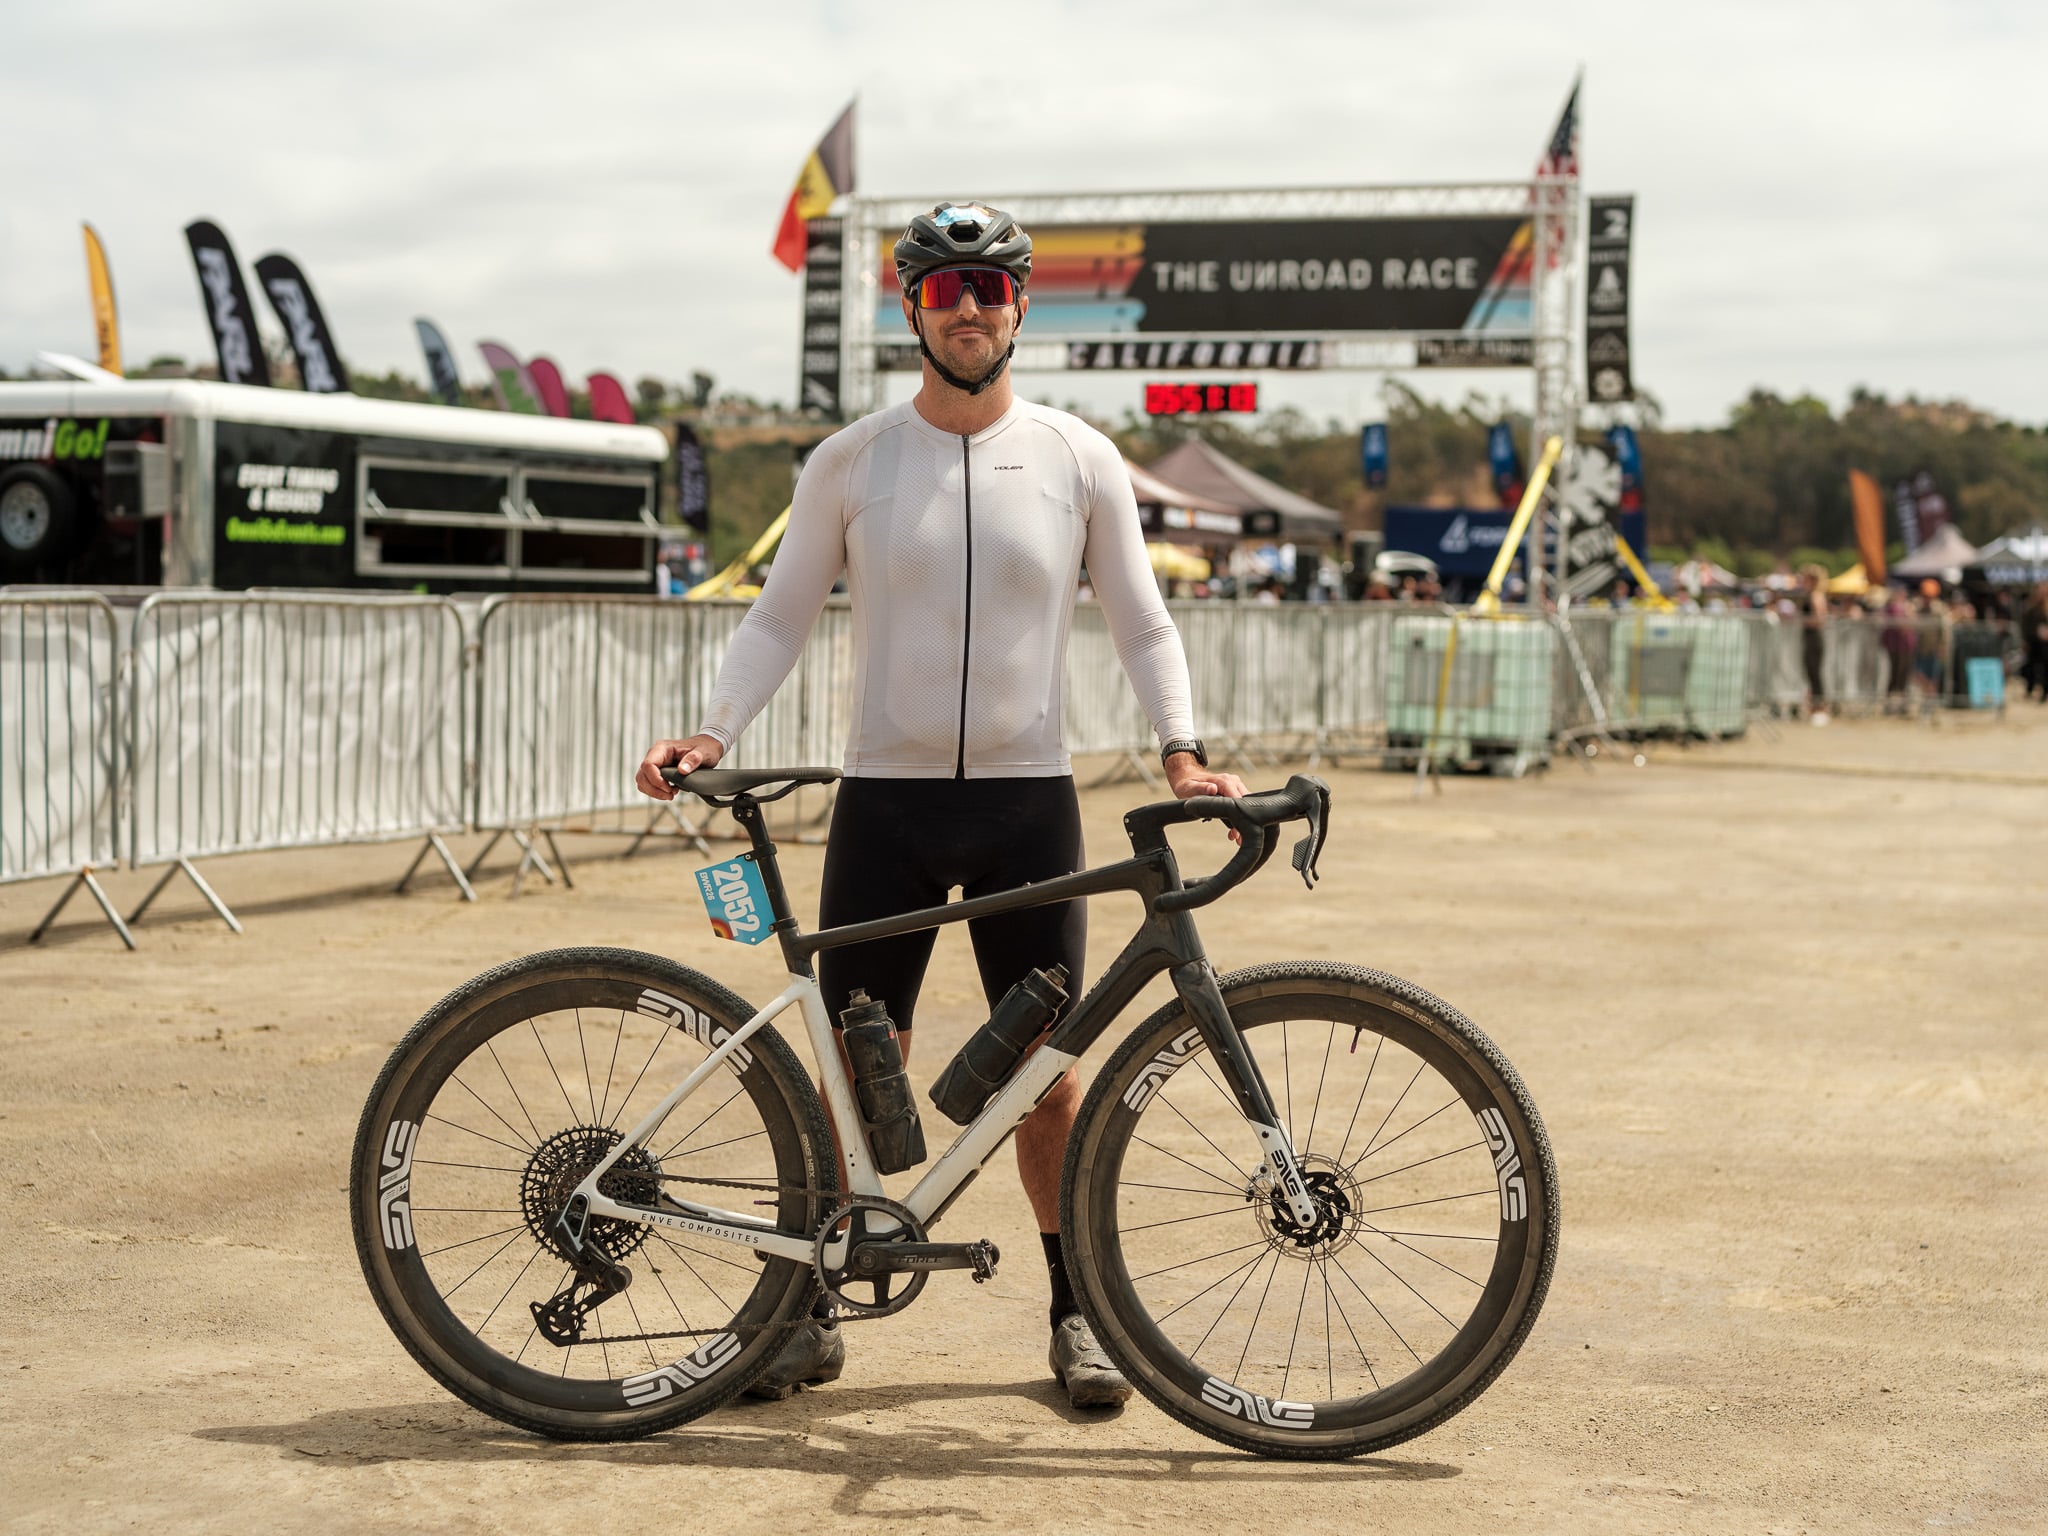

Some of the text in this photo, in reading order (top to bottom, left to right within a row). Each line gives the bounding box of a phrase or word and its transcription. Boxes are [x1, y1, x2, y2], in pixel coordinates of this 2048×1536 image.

[1153, 261, 1219, 292] THE
[1382, 257, 1479, 290] RACE
[1069, 341, 1317, 369] CALIFORNIA
[712, 863, 760, 937] 2052
[379, 1120, 419, 1250] ENVE
[1271, 1149, 1301, 1197] ENVE
[1476, 1107, 1527, 1221] ENVE
[641, 1213, 760, 1244] ENVE COMPOSITES
[622, 1332, 742, 1407] ENVE
[1201, 1376, 1315, 1429] ENVE
